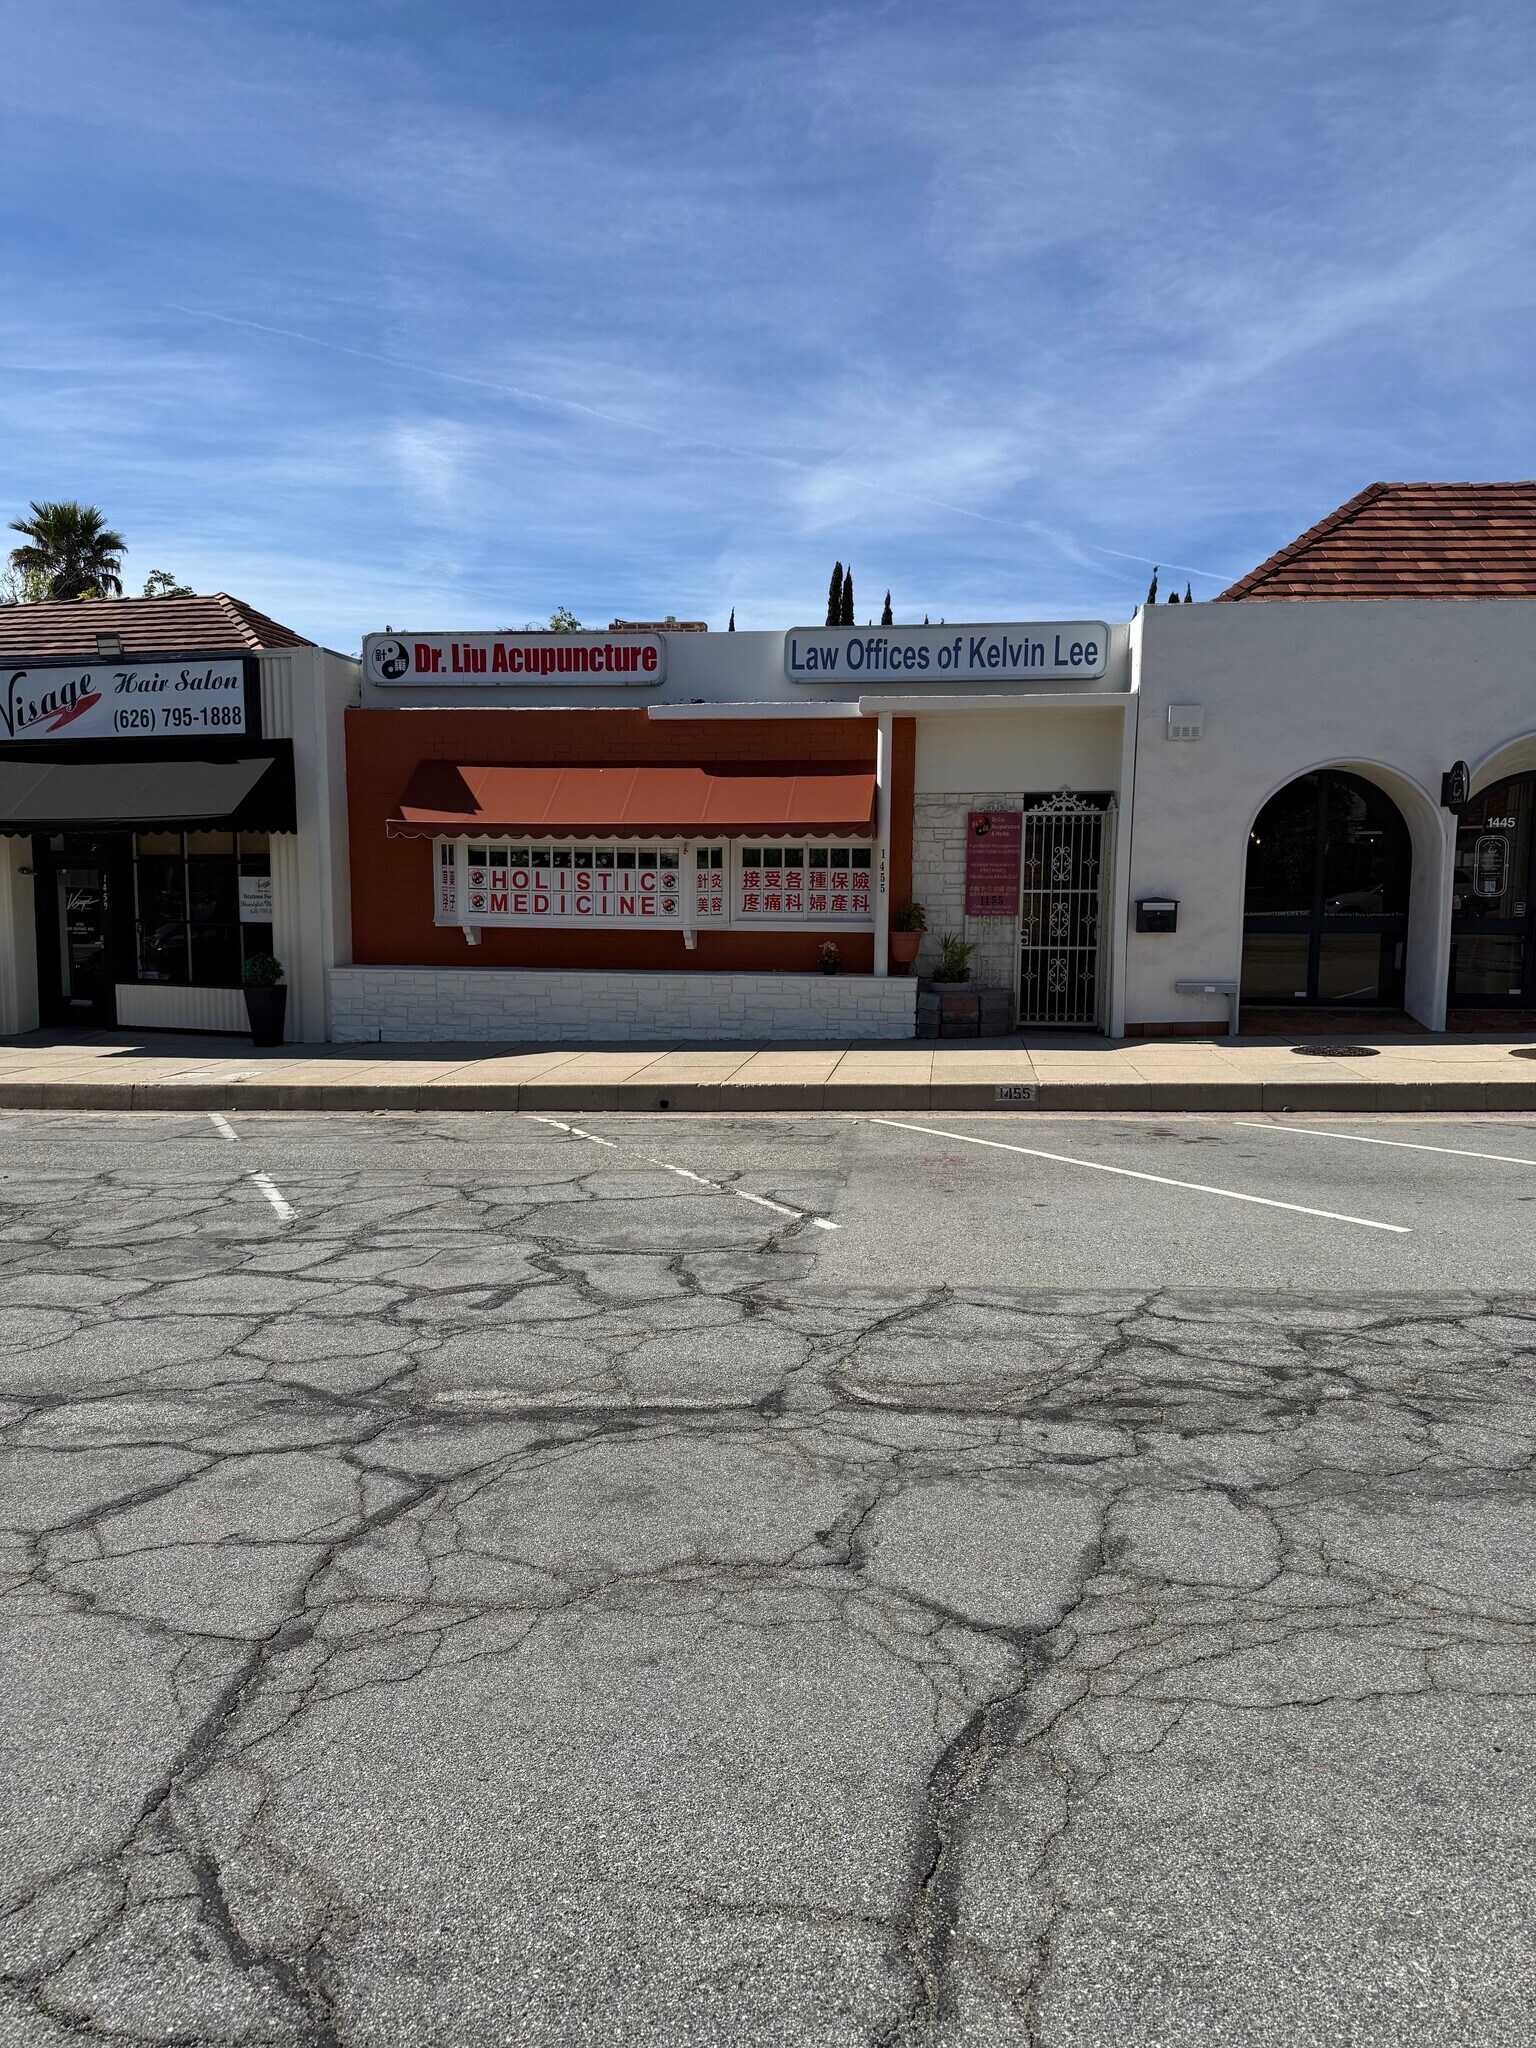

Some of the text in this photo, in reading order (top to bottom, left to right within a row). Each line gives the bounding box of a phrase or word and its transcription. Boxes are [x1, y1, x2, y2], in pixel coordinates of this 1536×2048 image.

[414, 643, 658, 676] Dr. Liu Acupuncture
[791, 634, 1098, 670] Law Offices of Kelvin Lee
[112, 669, 239, 694] Hair Salon
[0, 671, 97, 738] Visage
[113, 705, 242, 733] (626) 795-1888
[1487, 817, 1516, 828] 1445
[491, 869, 656, 892] HOLISTIC
[697, 873, 723, 889] 針灸
[742, 870, 871, 890] 接受各種保險
[879, 849, 887, 894] 1455
[490, 893, 656, 916] MEDICINE
[697, 896, 723, 912] 美容
[742, 893, 871, 913] 疼痛科婦產科
[980, 896, 1004, 906] 1455
[999, 1087, 1031, 1100] 1455
